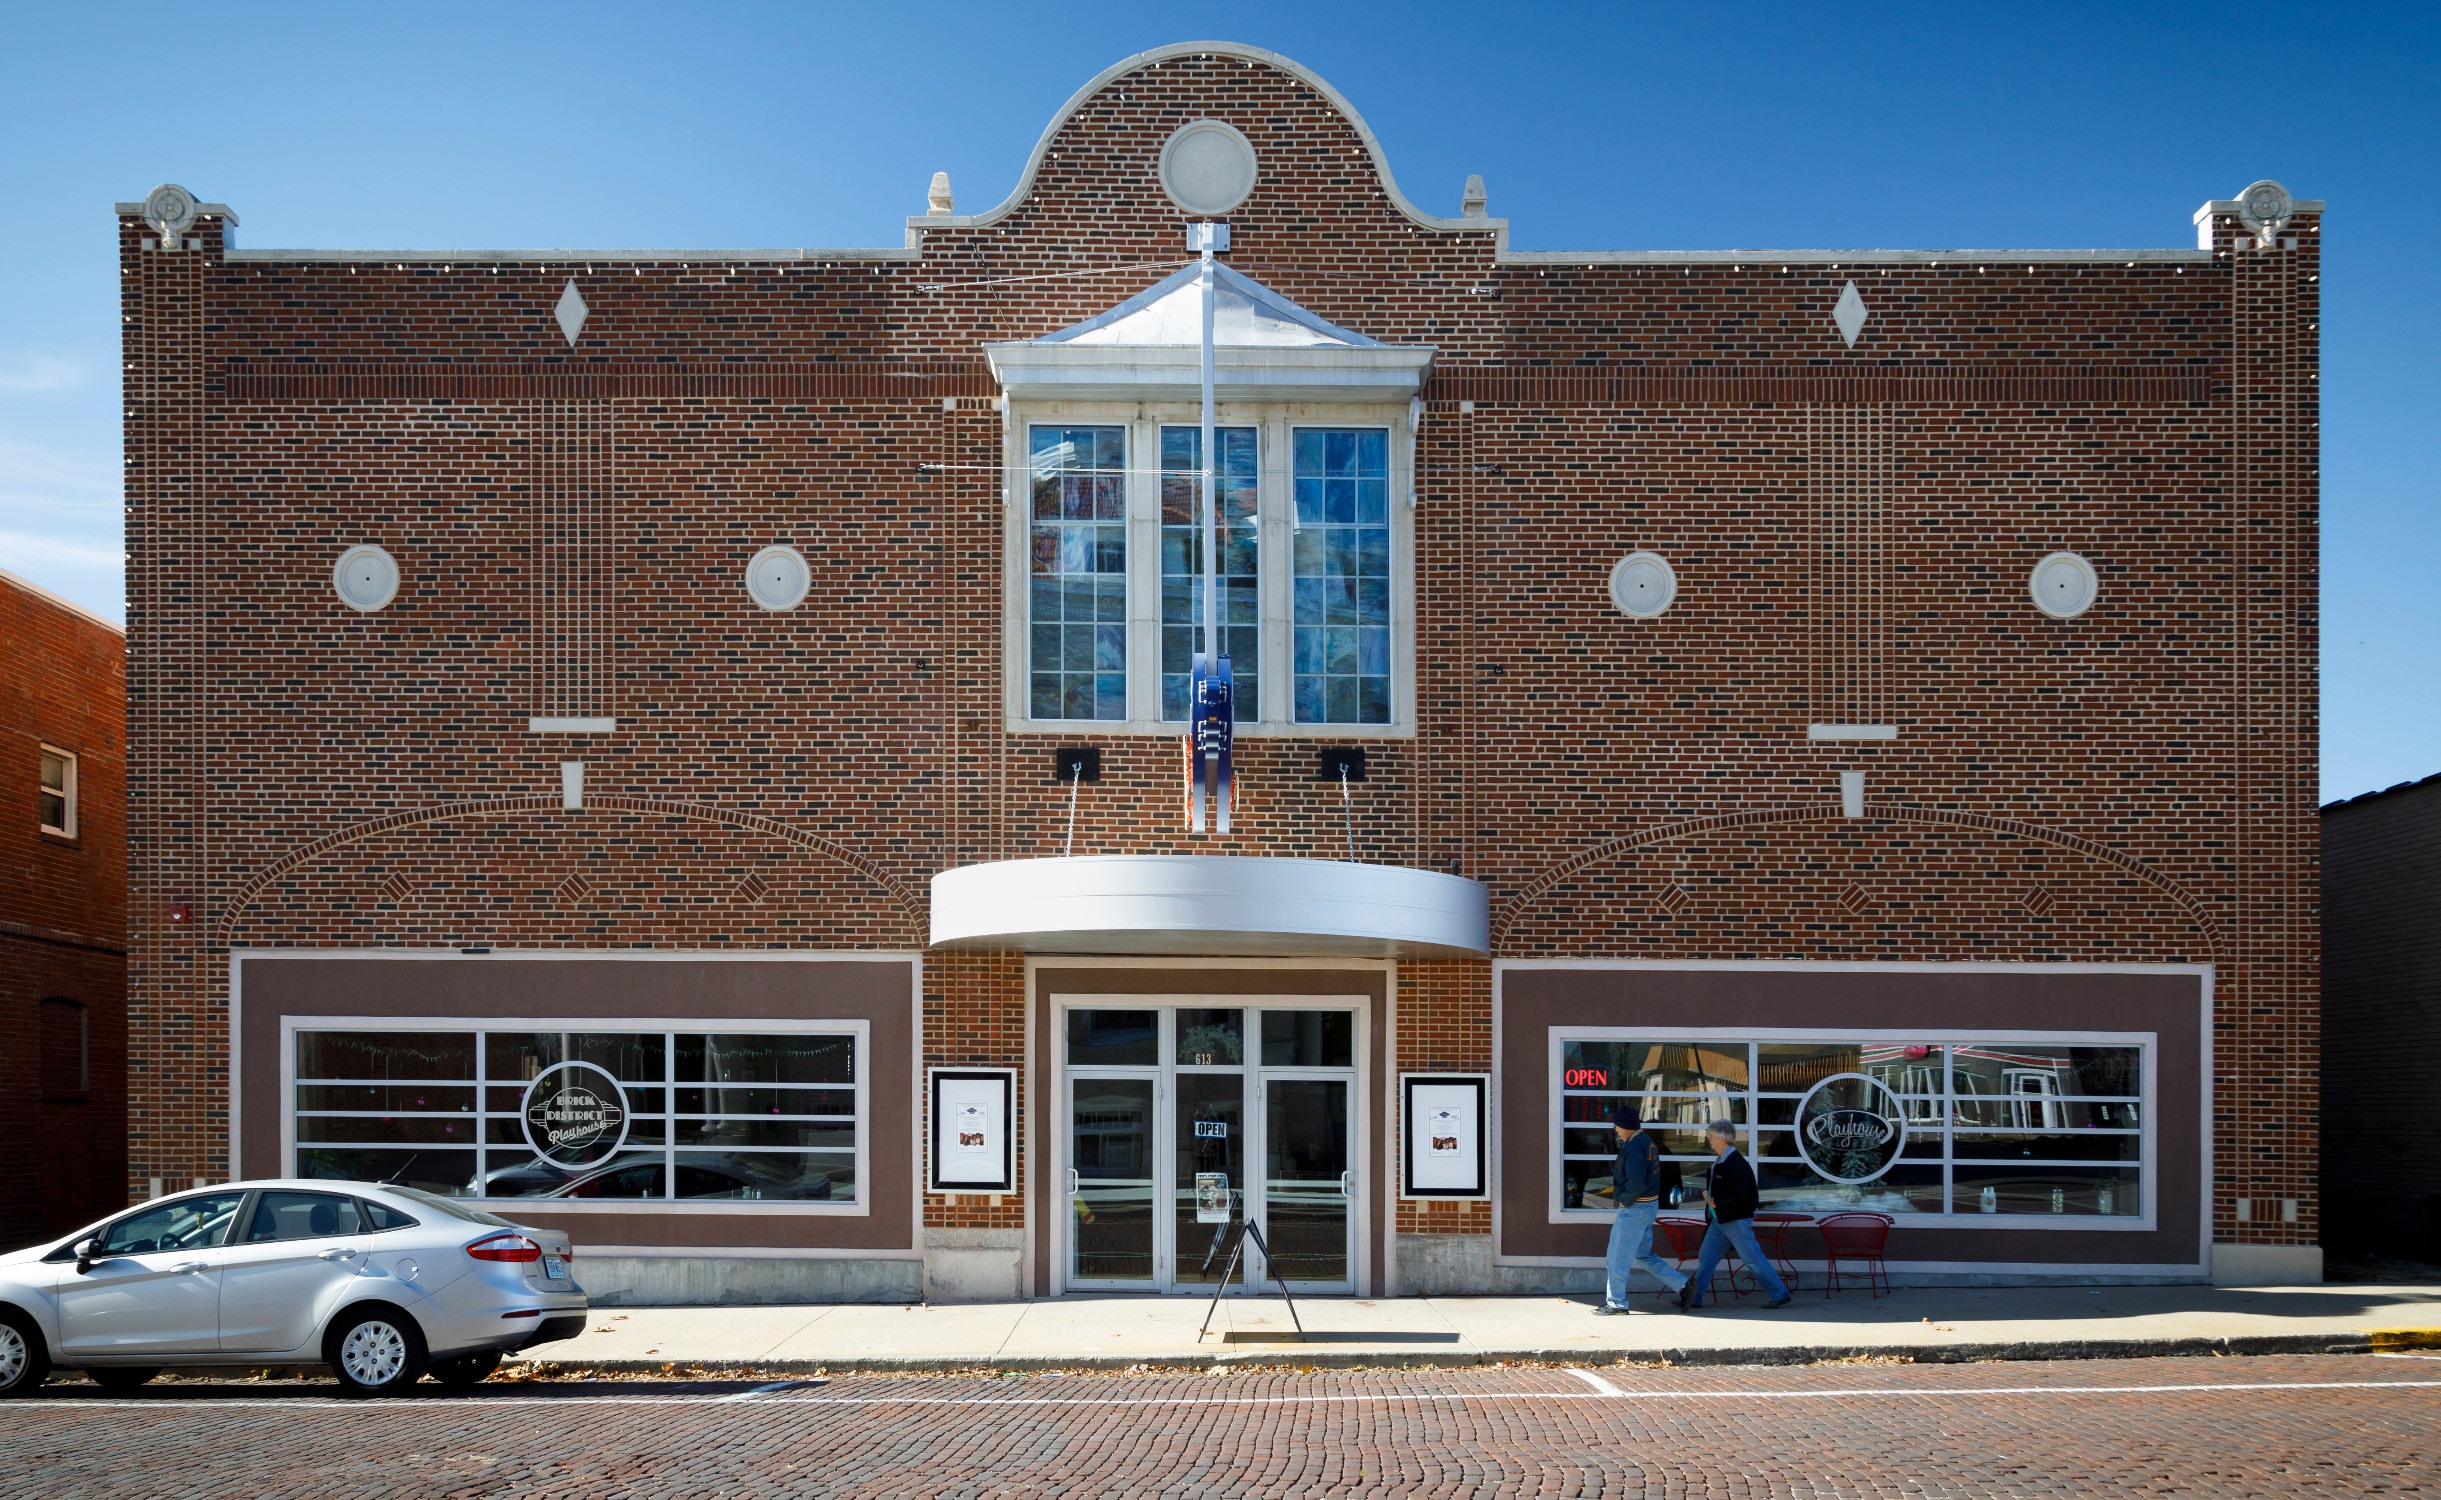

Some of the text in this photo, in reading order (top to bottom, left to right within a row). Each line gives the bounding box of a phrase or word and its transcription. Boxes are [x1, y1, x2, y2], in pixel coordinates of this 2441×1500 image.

[1195, 1053, 1212, 1065] 613
[1565, 1069, 1607, 1086] OPEN
[556, 1095, 596, 1106] BRICK
[546, 1110, 605, 1121] DISTRICT
[548, 1120, 606, 1145] Playhouse
[1197, 1122, 1225, 1136] OPEN
[1809, 1112, 1886, 1148] Playhouse
